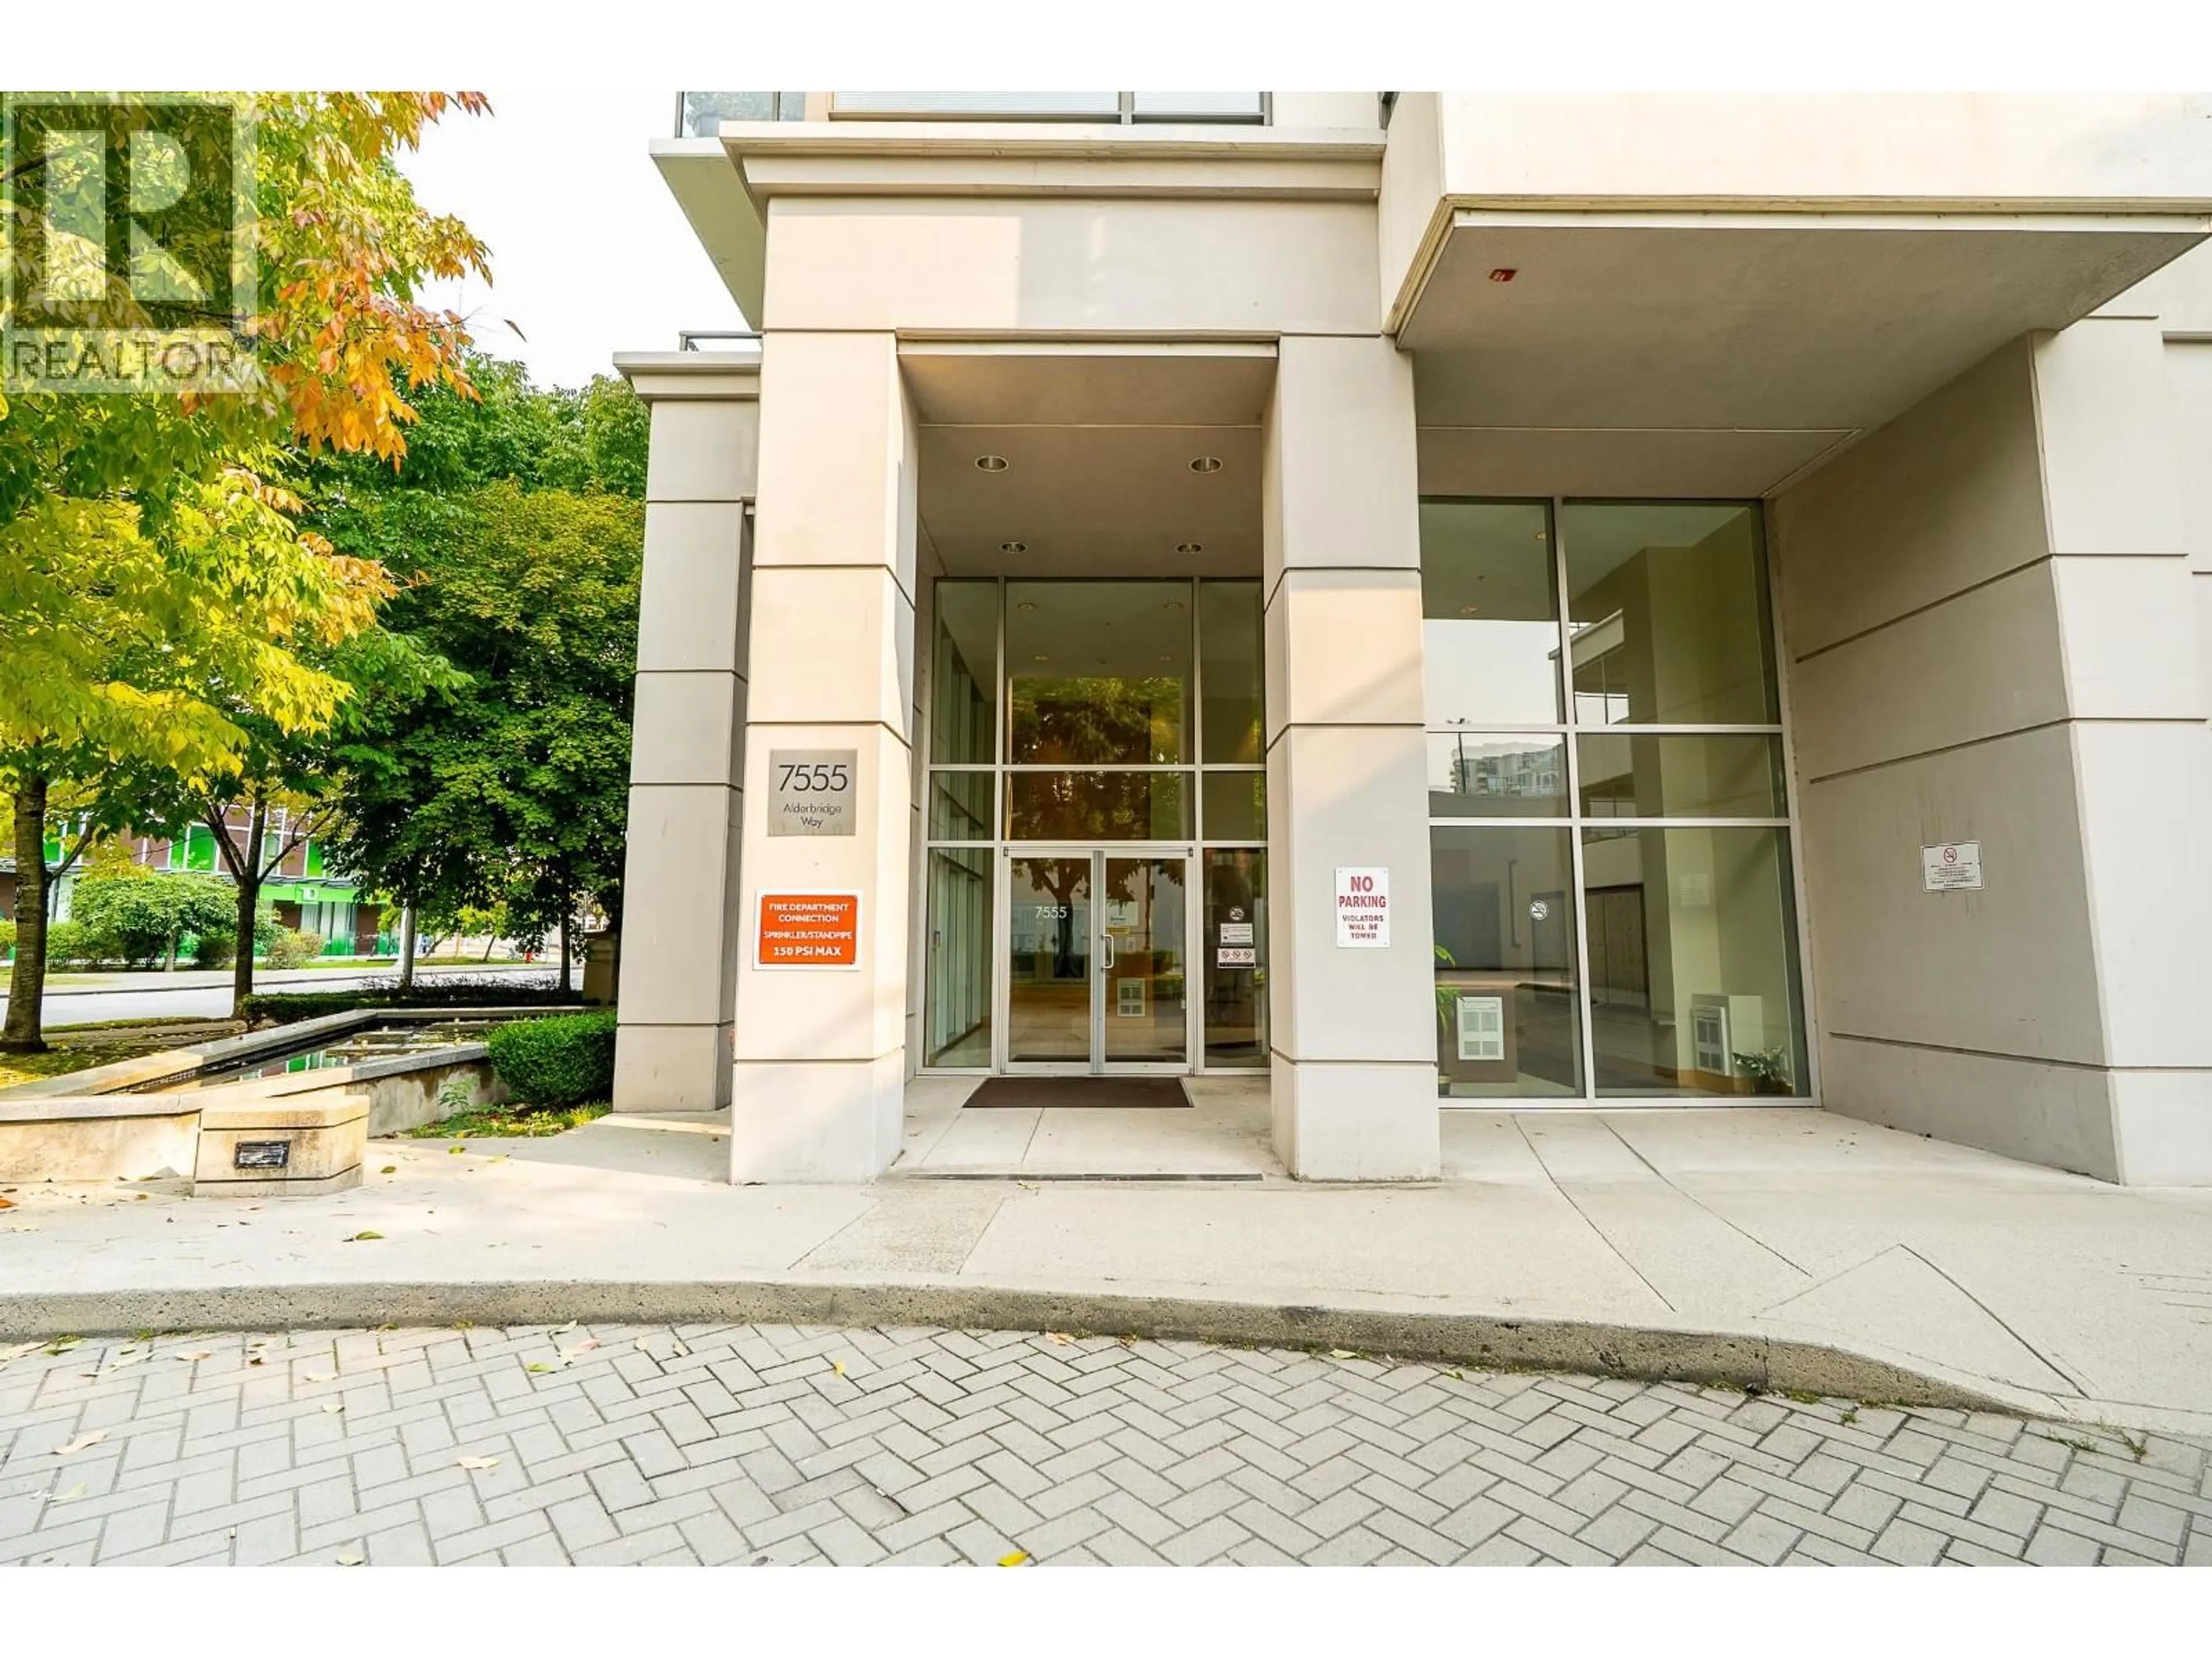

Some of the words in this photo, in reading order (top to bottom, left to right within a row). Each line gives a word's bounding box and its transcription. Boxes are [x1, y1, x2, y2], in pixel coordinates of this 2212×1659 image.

[778, 764, 848, 792] 7555
[783, 802, 842, 816] Alderbridge
[800, 816, 824, 829] Way
[1350, 876, 1374, 892] NO
[768, 903, 789, 912] FIRE
[790, 903, 850, 912] DEPARTMENT
[1338, 895, 1387, 908] PARKING
[778, 914, 839, 923] CONNECTION
[1035, 906, 1067, 919] 7555
[774, 946, 794, 956] 150
[794, 946, 815, 956] PSI
[815, 946, 842, 956] MAX
